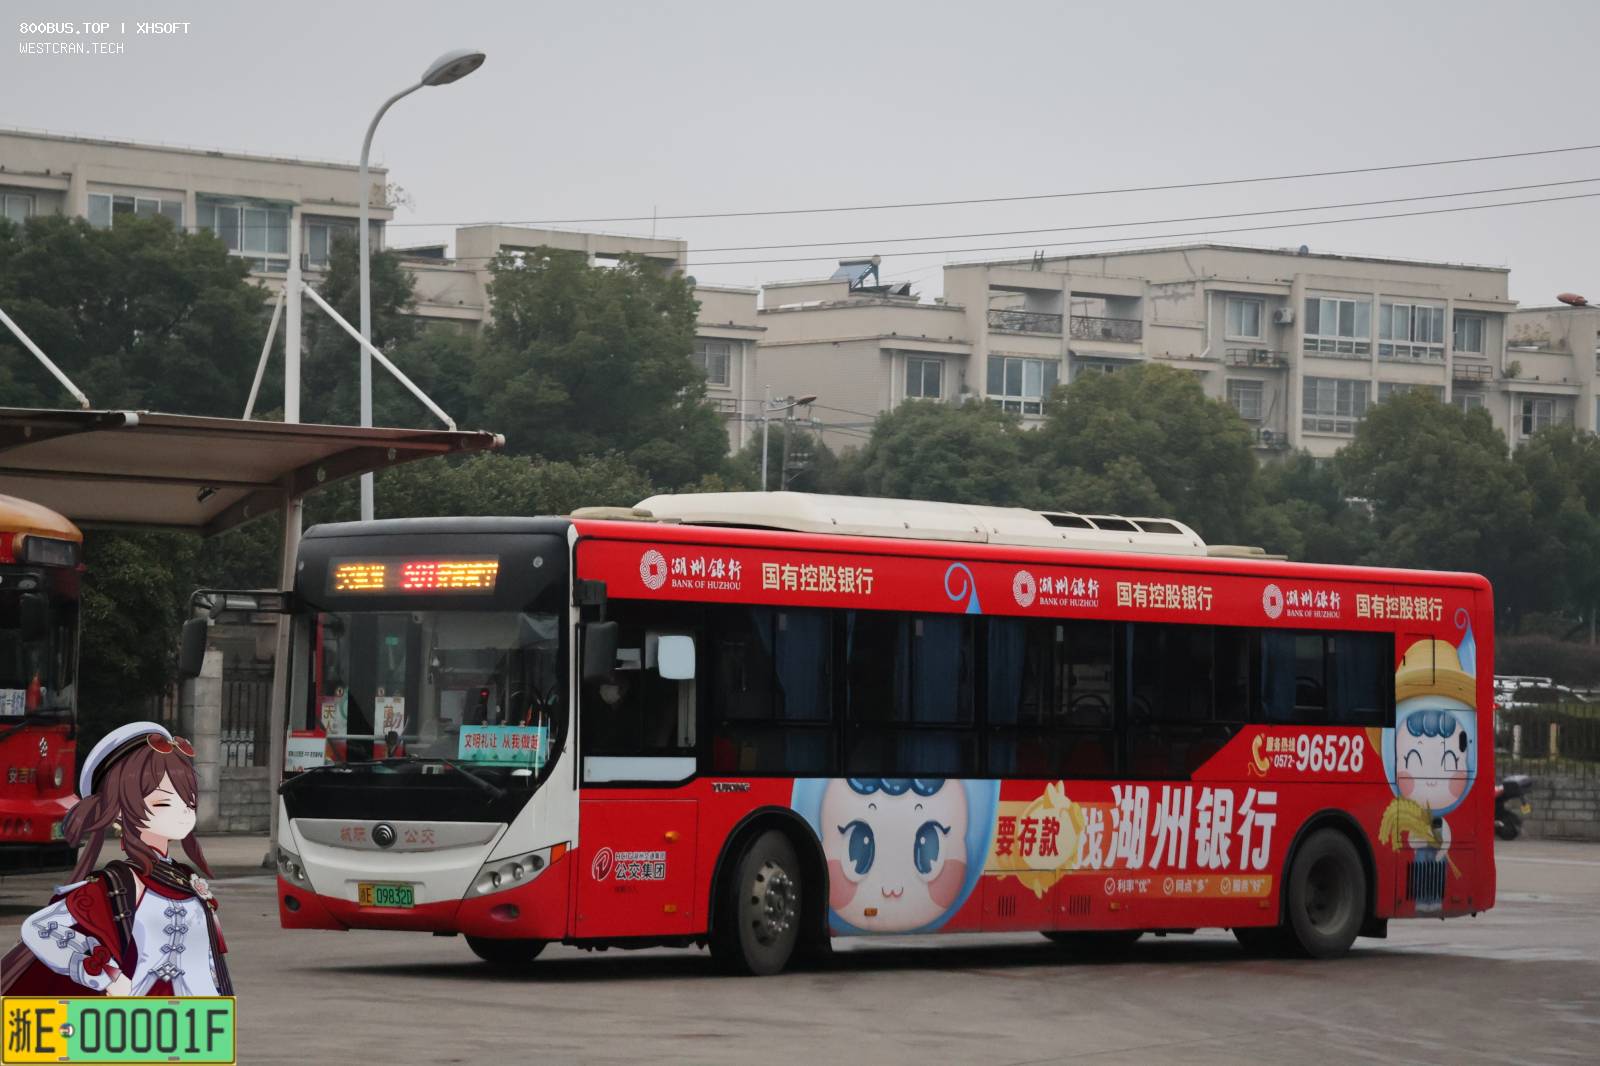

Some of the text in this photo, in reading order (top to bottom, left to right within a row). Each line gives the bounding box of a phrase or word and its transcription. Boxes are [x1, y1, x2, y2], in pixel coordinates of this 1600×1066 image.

[671, 556, 742, 580] 湖州银行
[762, 562, 874, 594] 国有控股银行
[671, 579, 741, 590] BANK OF HUZHOU
[1039, 576, 1099, 598] 湖州银行
[1116, 581, 1213, 611] 国有控股银行
[1039, 597, 1099, 607] BANK OF HUZHOU
[1287, 609, 1304, 617] BANK
[1356, 594, 1443, 621] 国有控股银行
[464, 733, 497, 749] 文明礼让
[1296, 734, 1364, 772] 96528
[995, 815, 1061, 858] 要存款
[615, 862, 666, 880] 公交集团
